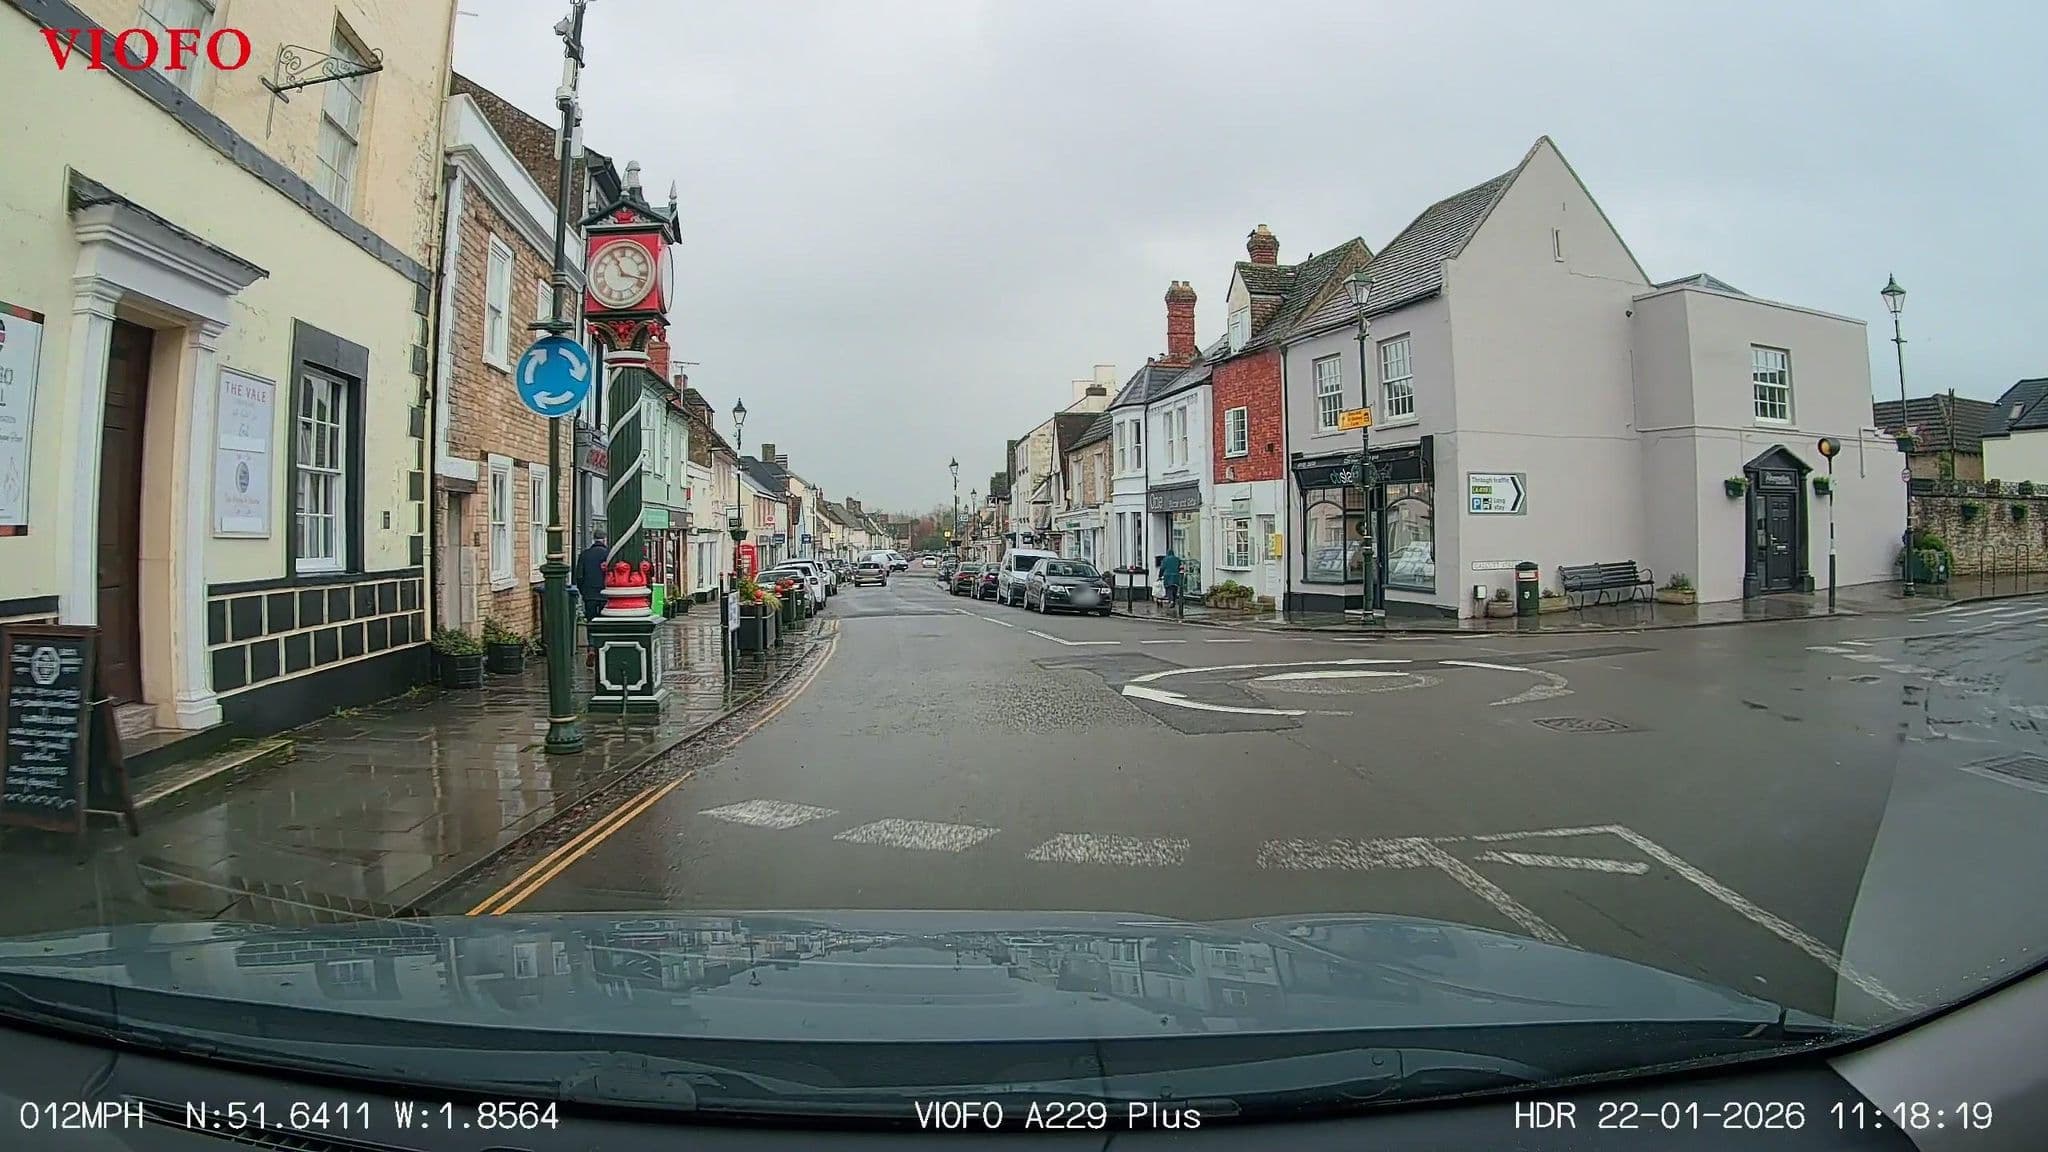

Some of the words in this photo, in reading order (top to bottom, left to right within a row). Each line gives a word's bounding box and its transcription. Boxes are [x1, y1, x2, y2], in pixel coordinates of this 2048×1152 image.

[225, 381, 243, 397] THE
[246, 387, 267, 403] VALE
[1493, 475, 1510, 483] traffic
